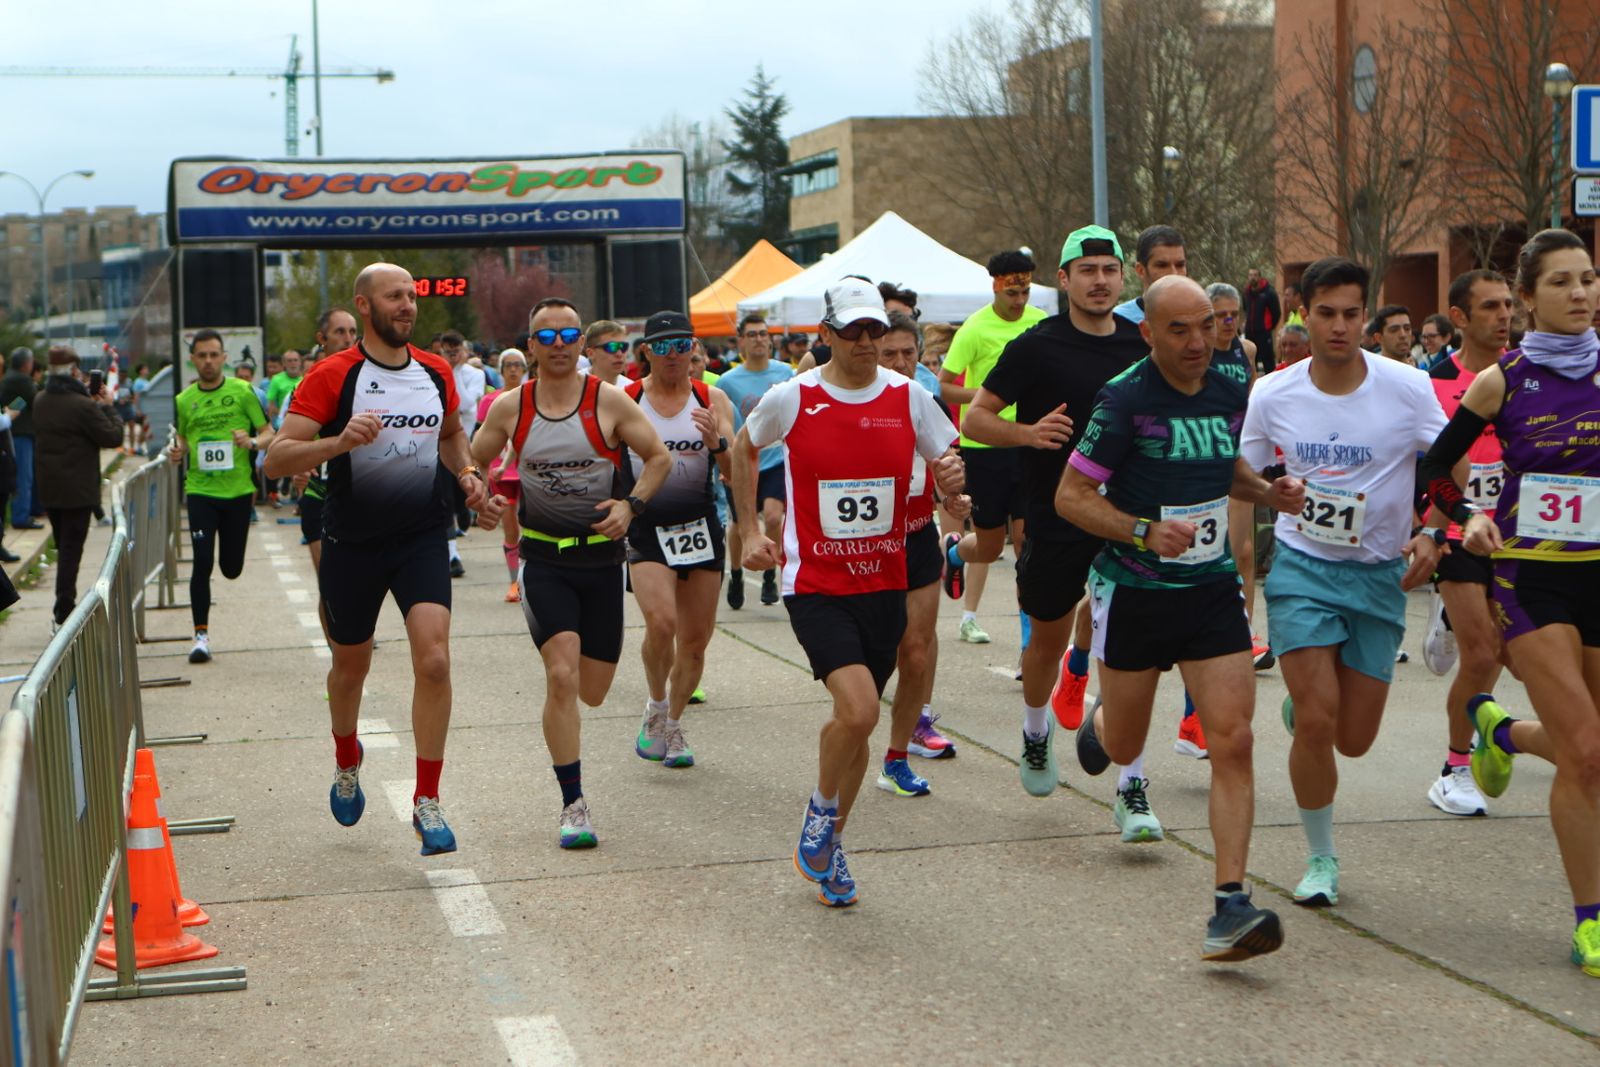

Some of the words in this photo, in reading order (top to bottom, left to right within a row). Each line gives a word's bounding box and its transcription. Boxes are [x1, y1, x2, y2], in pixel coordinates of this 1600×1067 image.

[247, 205, 621, 230] www.orycronsport.com
[378, 414, 439, 428] 7300
[1167, 416, 1235, 461] AVS
[1568, 435, 1600, 446] Macot
[205, 449, 225, 462] 80
[1296, 442, 1331, 459] WHERE
[1333, 444, 1373, 462] SPORTS
[1468, 476, 1505, 498] 13
[837, 495, 879, 522] 93
[1302, 496, 1355, 530] 321
[1538, 493, 1582, 523] 31
[665, 531, 707, 555] 126
